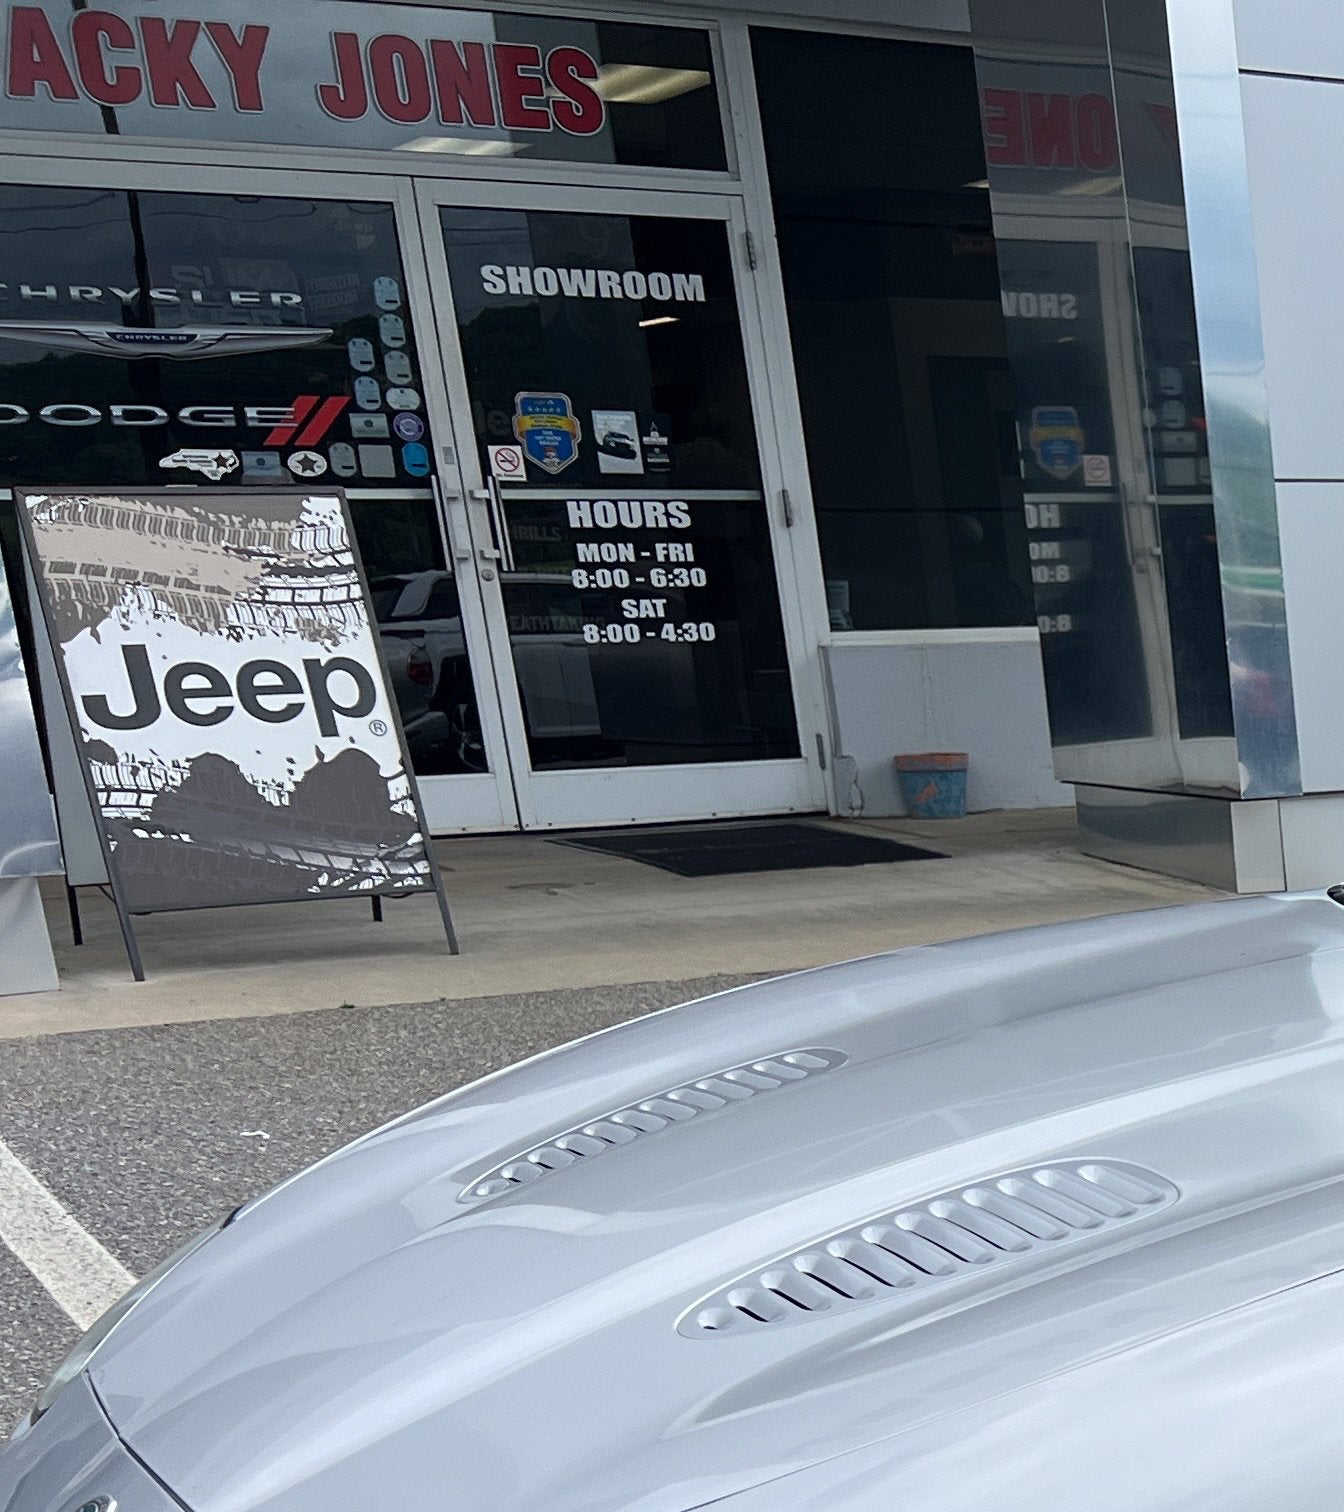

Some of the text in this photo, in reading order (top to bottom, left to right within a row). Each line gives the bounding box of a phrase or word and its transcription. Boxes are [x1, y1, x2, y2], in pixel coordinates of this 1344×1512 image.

[6, 4, 606, 137] ACKY JONES
[480, 264, 706, 302] SHOWROOM
[0, 284, 304, 307] HRYSLER
[566, 501, 692, 529] HOURS
[576, 543, 636, 562] MON
[655, 543, 695, 562] FRI
[572, 568, 630, 589] 8:00
[650, 568, 707, 588] 6:30
[621, 599, 668, 619] SAT
[583, 623, 641, 643] 8:00
[661, 622, 716, 642] 4:30
[80, 643, 378, 738] Jeep
